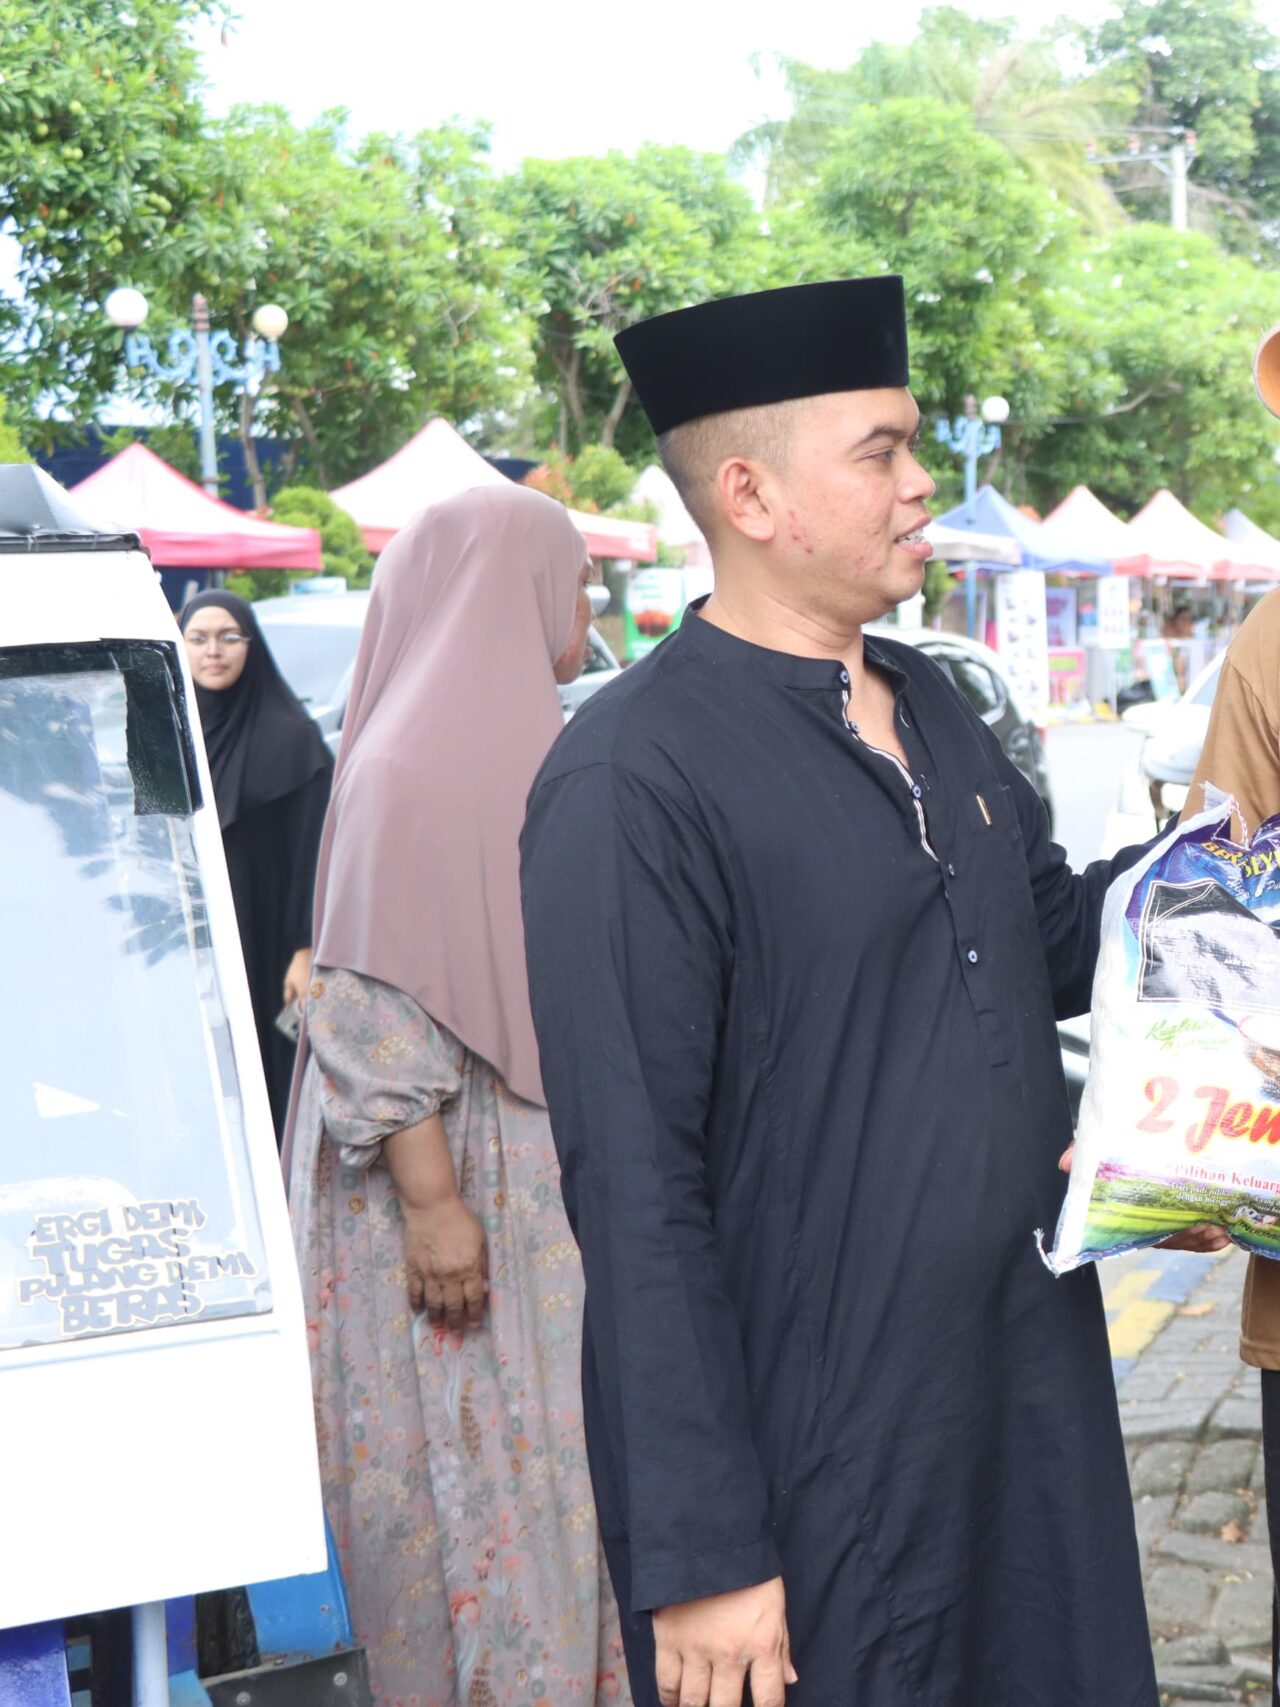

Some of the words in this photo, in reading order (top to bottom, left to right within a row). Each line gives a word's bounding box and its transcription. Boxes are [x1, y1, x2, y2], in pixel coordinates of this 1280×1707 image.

[1136, 1075, 1180, 1134] 2
[1176, 1191, 1203, 1203] dengan
[20, 1262, 159, 1303] PULANG
[165, 1251, 256, 1283] DEMI
[33, 1227, 192, 1276] TUGAS
[60, 1281, 204, 1334] BERAS
